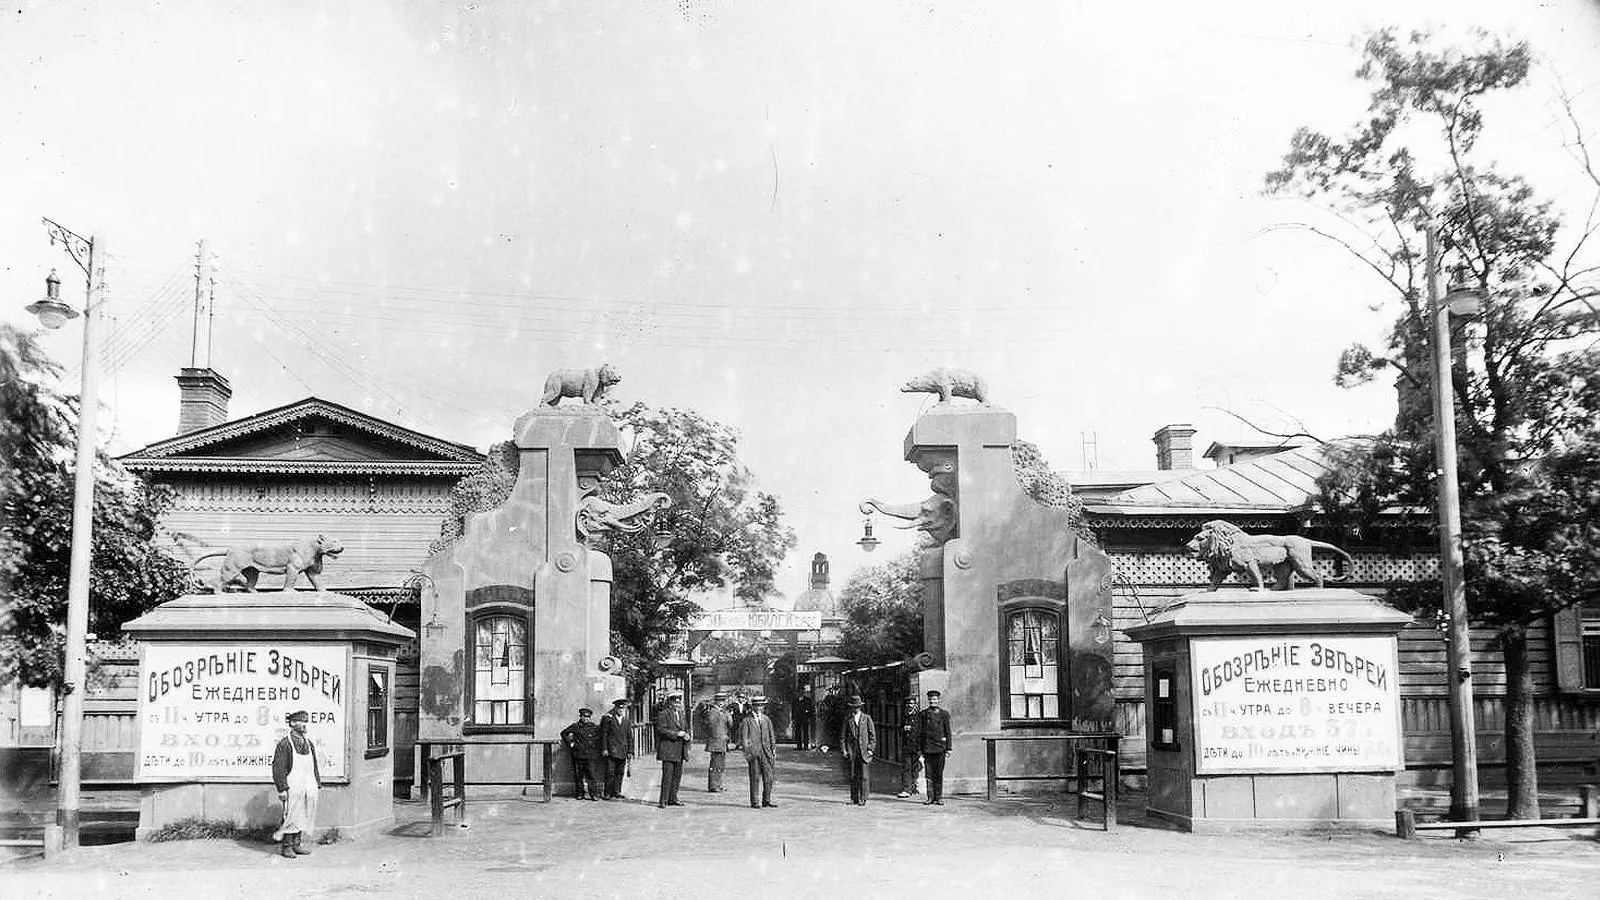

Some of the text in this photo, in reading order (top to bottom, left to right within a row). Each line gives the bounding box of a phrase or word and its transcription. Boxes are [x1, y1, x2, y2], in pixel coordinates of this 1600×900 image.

[1310, 642, 1388, 692] ЗВѢРЕЙ
[267, 649, 342, 704] ЗВѢРЕЙ
[192, 684, 301, 703] ЕЖЕДНЕВНО
[1244, 677, 1349, 694] ЕЖЕДНЕВНО
[1239, 703, 1272, 715] УТРА
[1328, 701, 1382, 715] ВЕЧЕРА
[194, 711, 230, 723] УТРА
[285, 711, 336, 724] ВЕРА
[159, 733, 262, 749] ВХОДЪ
[1220, 724, 1316, 741] ВХОДЪ
